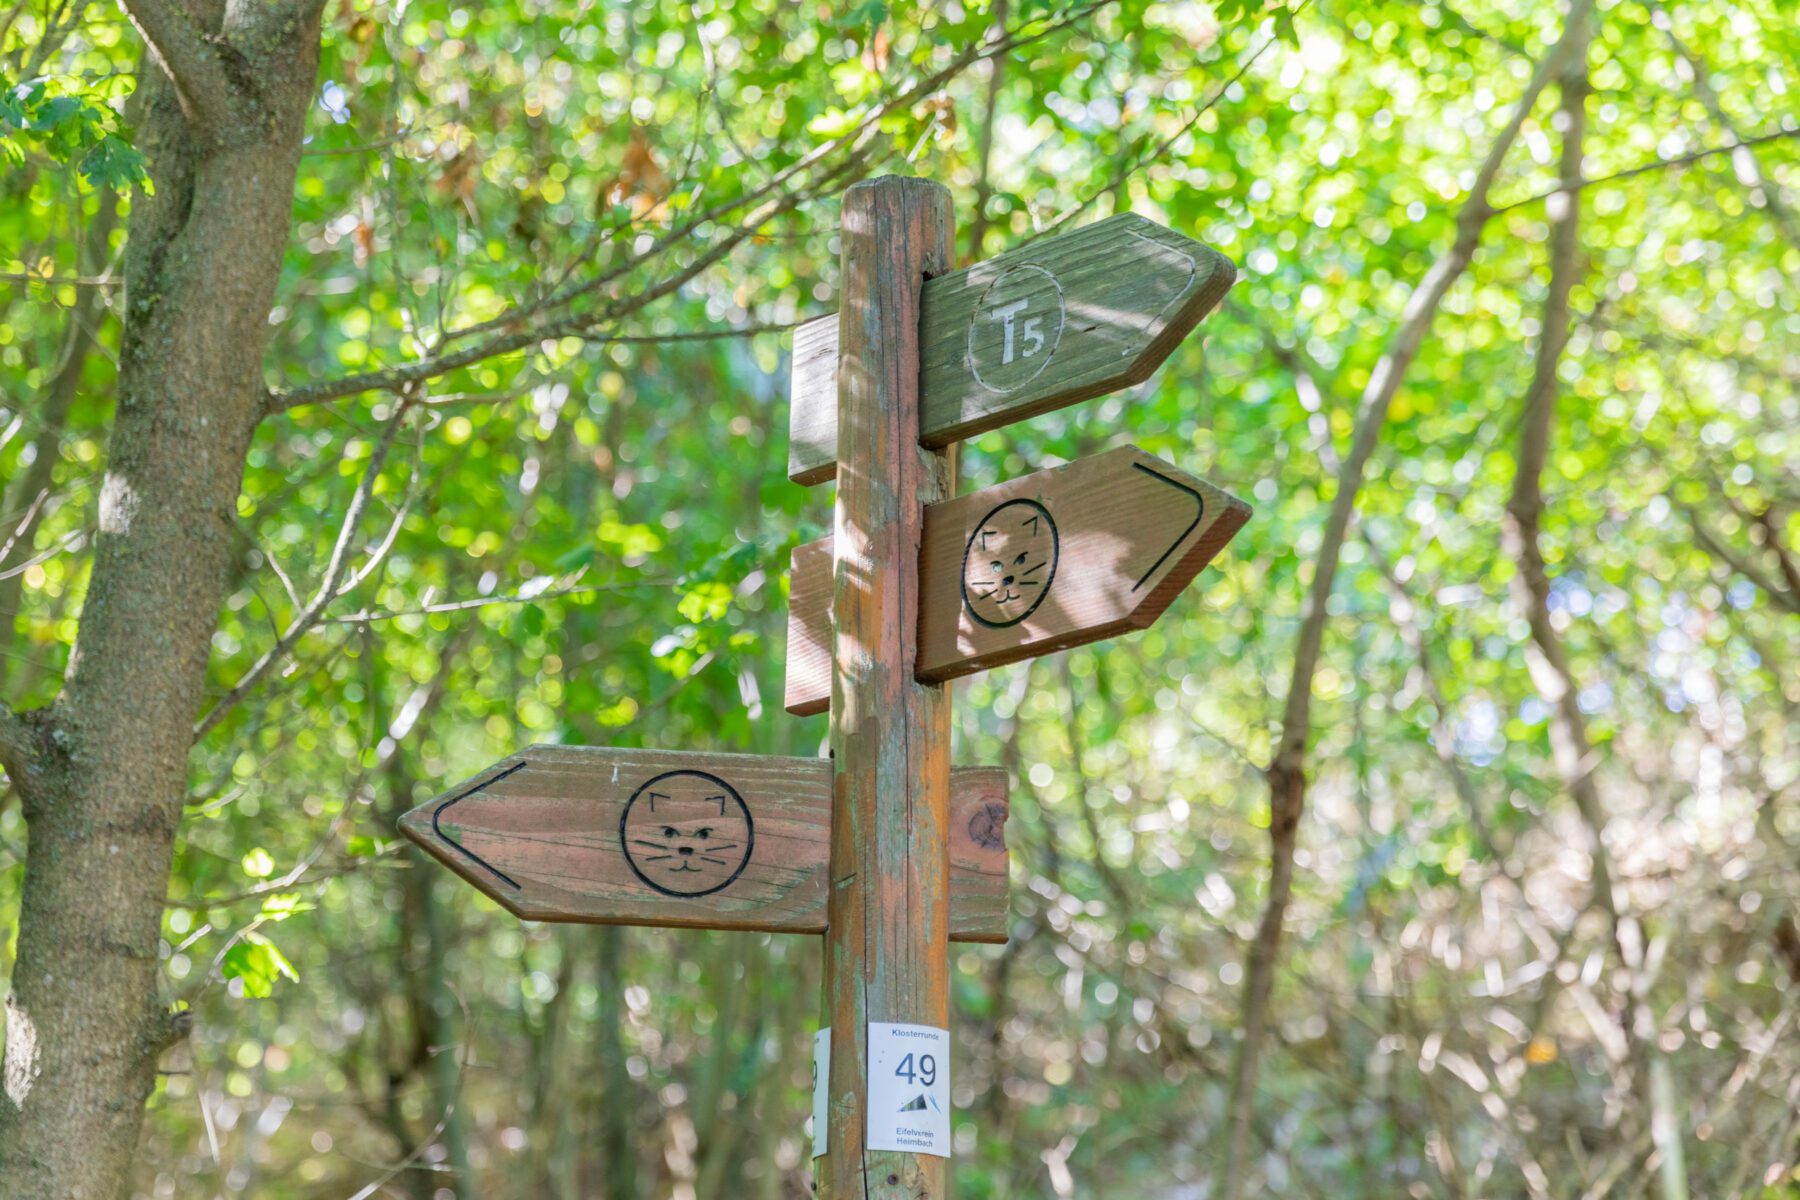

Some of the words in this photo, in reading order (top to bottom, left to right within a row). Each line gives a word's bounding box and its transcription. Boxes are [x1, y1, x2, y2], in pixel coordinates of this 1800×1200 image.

[990, 298, 1045, 365] T5
[891, 1029, 939, 1041] Klosterrunde
[895, 1052, 936, 1087] 49
[896, 1127, 934, 1138] Eifelverein
[896, 1137, 933, 1147] Heimbach
